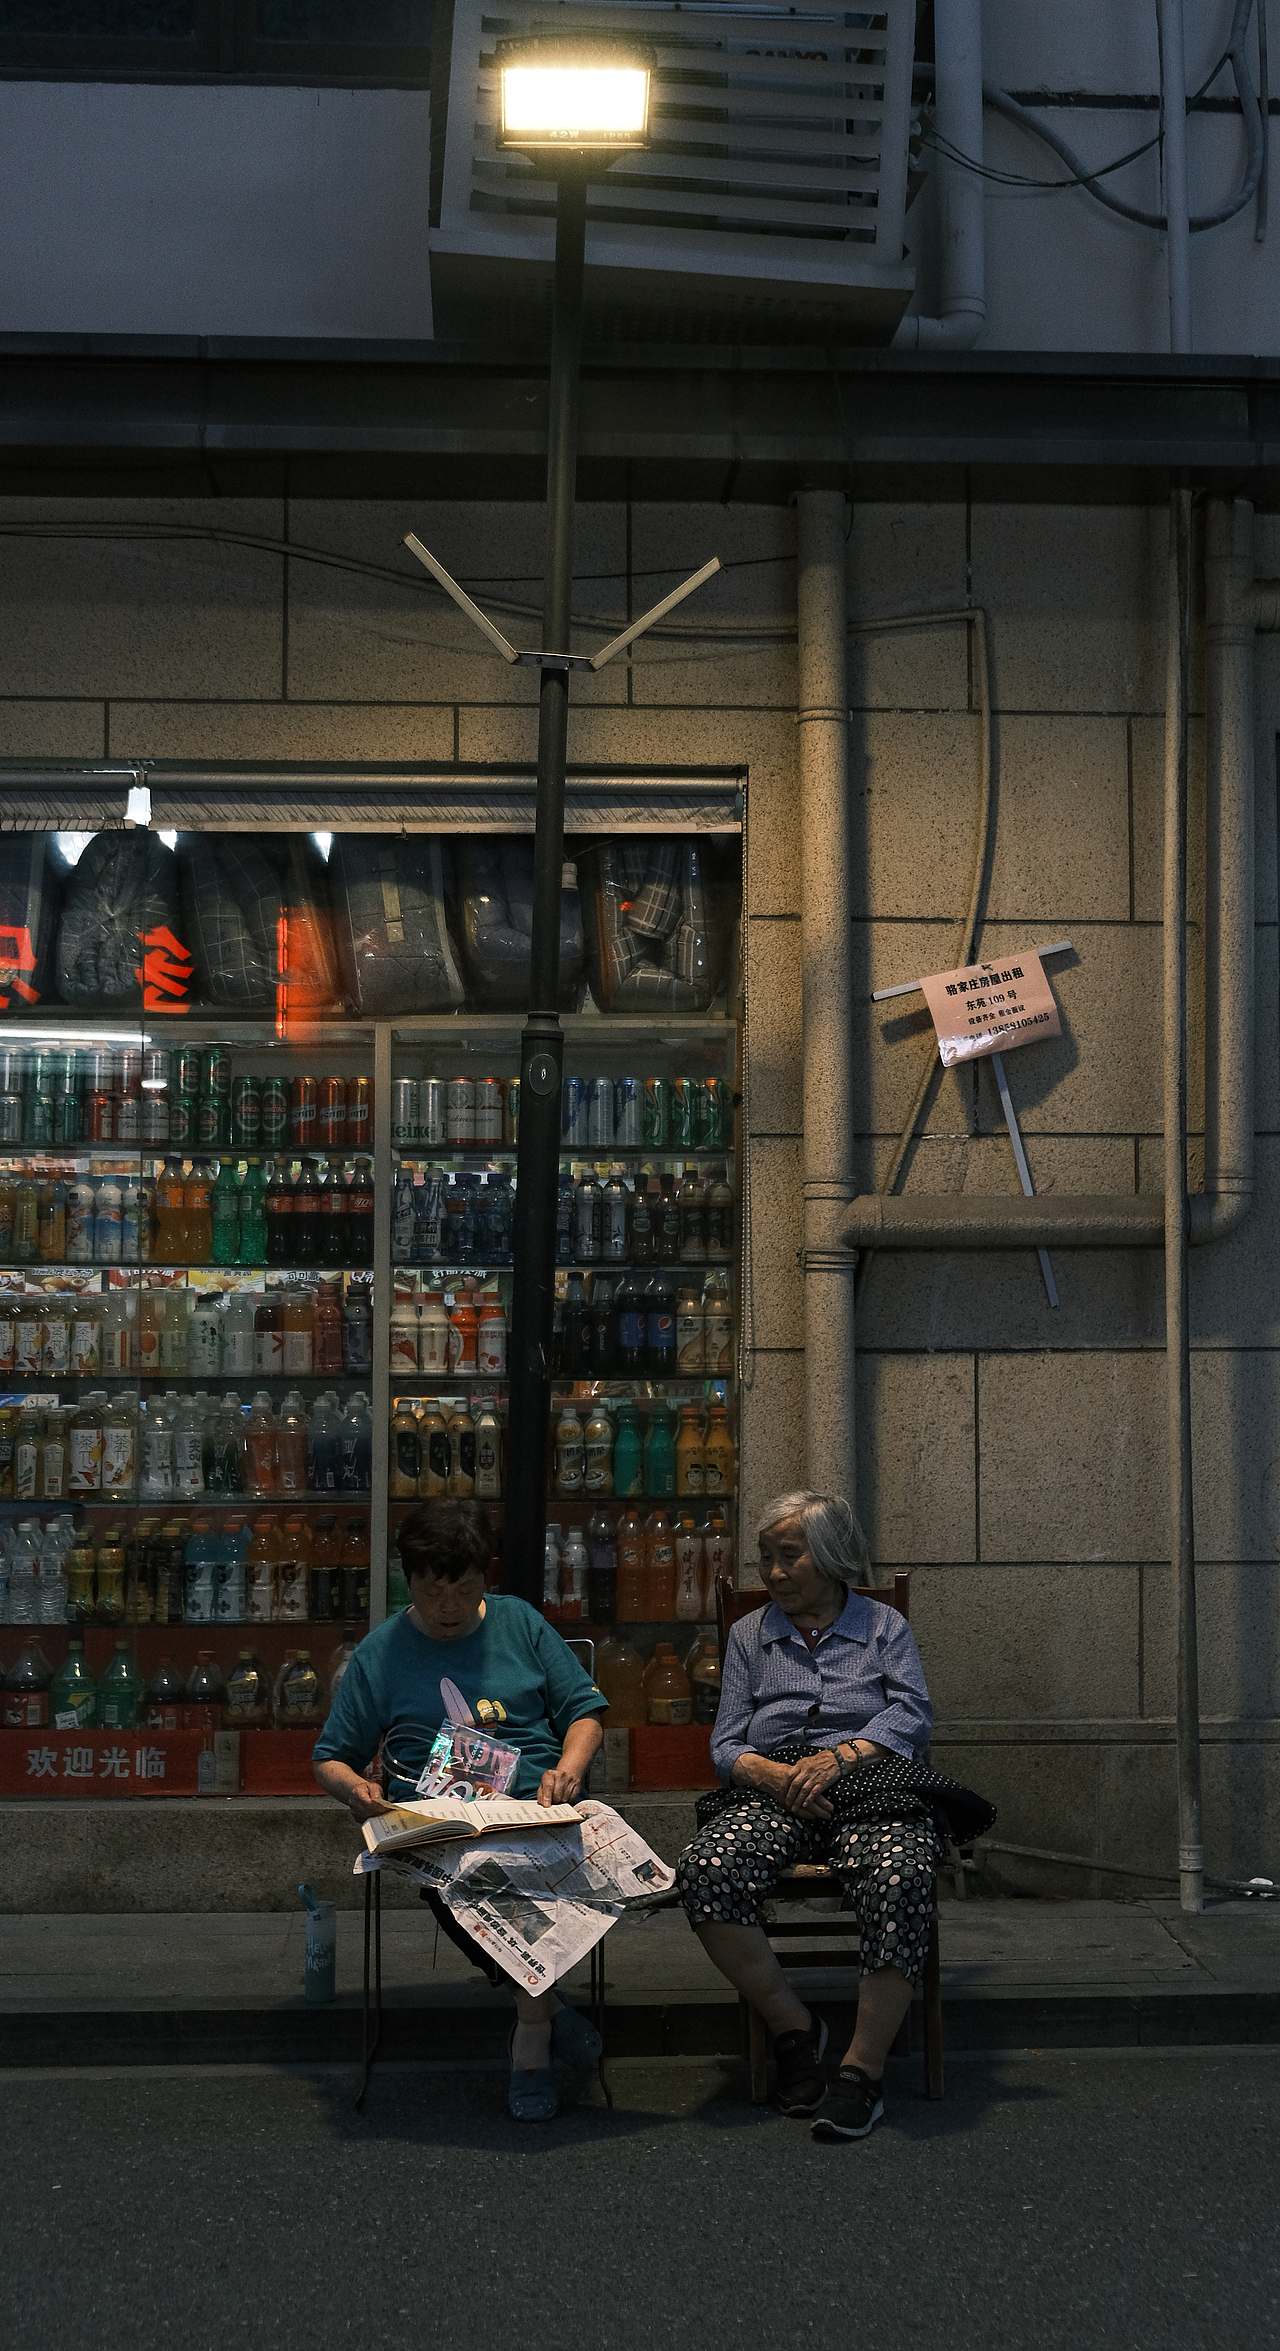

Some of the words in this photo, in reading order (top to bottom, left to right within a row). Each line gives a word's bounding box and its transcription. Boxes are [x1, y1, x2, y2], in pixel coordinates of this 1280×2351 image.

[549, 130, 580, 139] 42W
[945, 967, 1025, 996] 骆家庄房屋出租
[988, 993, 1006, 1006] 109
[1006, 989, 1018, 1000] 号
[26, 1746, 167, 1778] 欢迎光临
